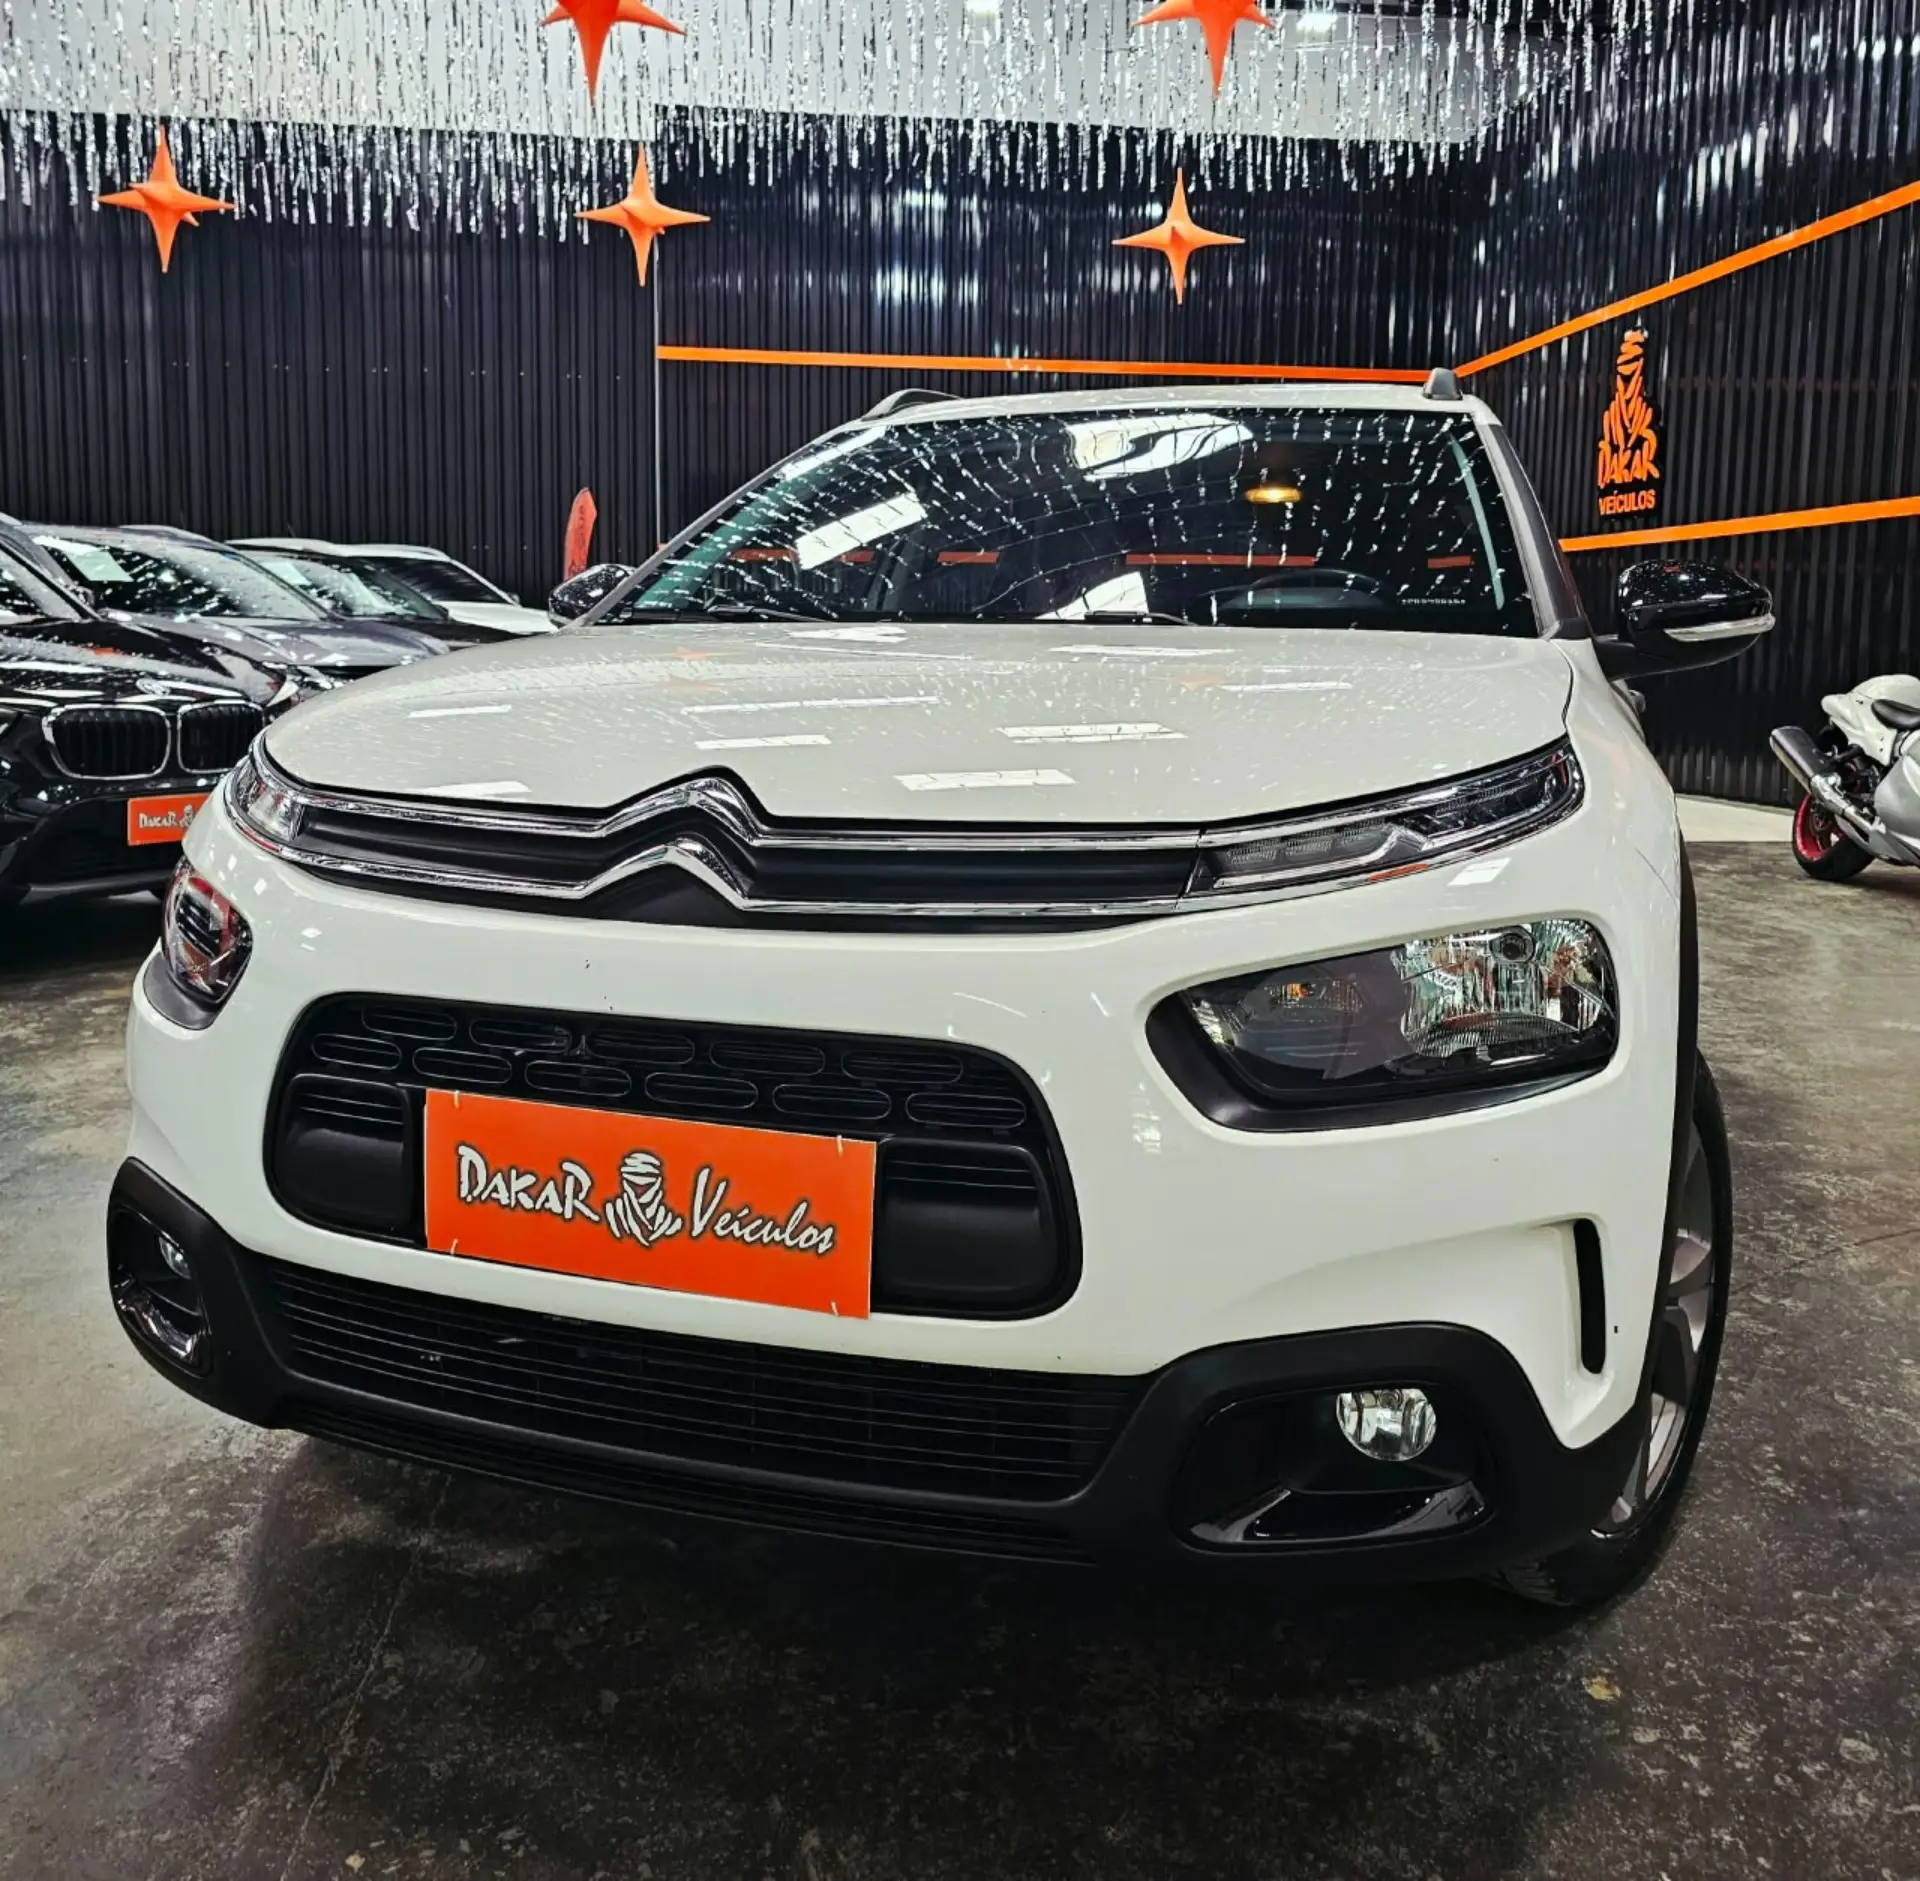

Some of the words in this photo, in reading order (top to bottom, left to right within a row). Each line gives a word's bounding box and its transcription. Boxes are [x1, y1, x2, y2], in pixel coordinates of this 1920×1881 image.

[1598, 428, 1660, 489] DAKAR
[138, 810, 178, 829] DAKAR
[456, 1143, 600, 1223] DAKAR
[690, 1165, 836, 1256] Veículos
